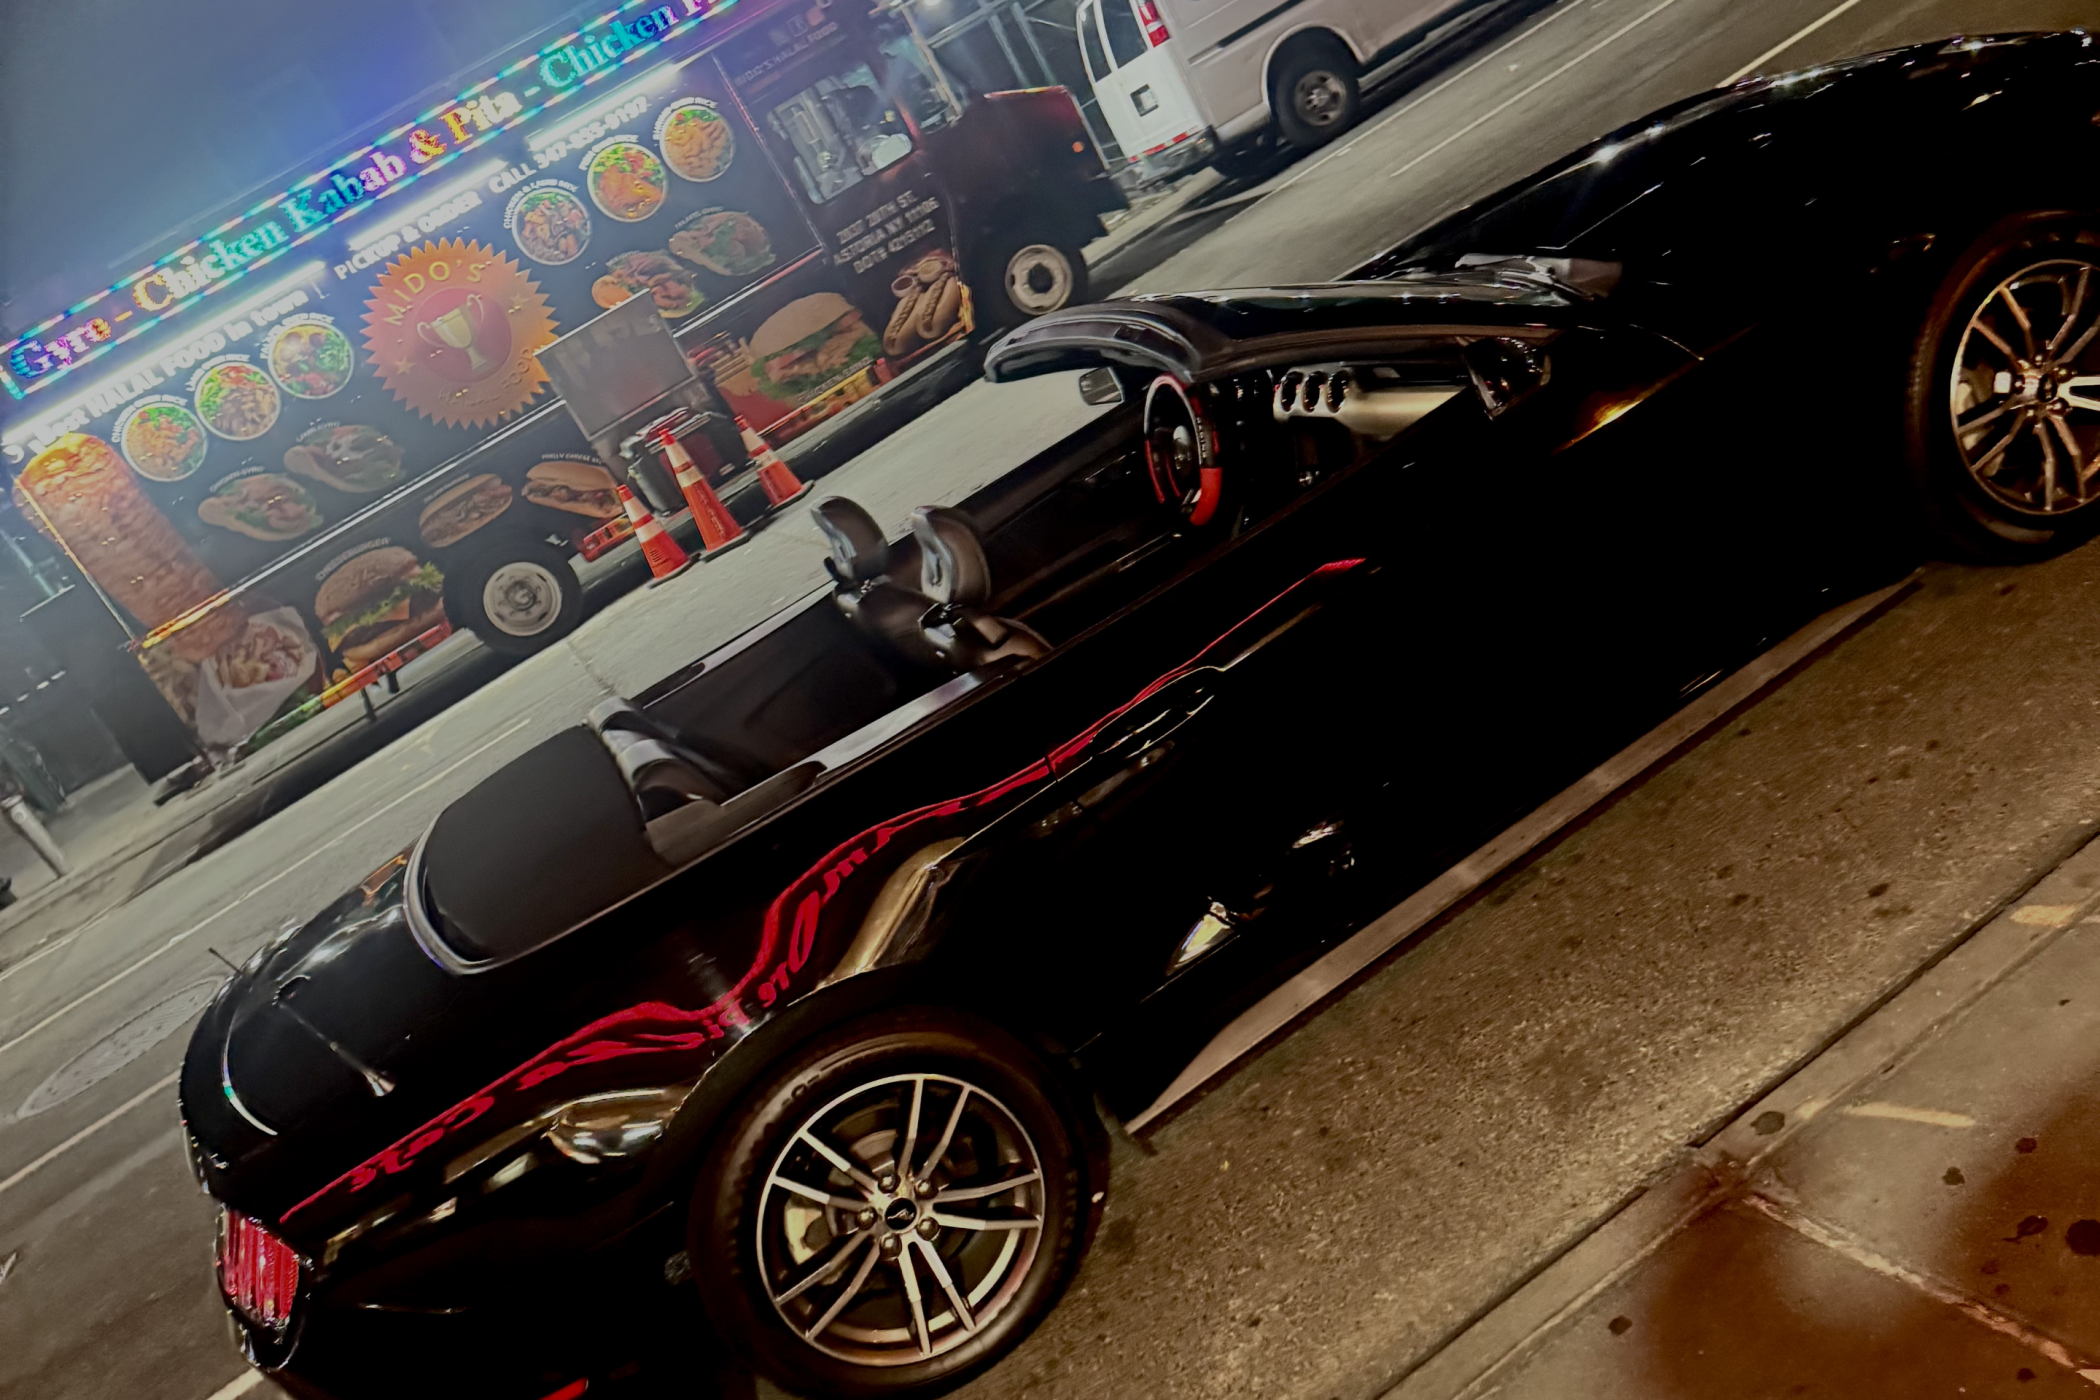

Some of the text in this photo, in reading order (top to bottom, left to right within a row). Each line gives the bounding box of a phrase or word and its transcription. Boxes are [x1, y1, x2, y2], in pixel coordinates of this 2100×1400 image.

[10, 318, 111, 378] Gyro
[133, 221, 289, 311] Chicken
[278, 152, 406, 233] Kabab
[409, 129, 447, 164] &
[439, 90, 523, 145] Pita
[539, 6, 679, 88] Chicken
[488, 163, 537, 194] CALL
[334, 191, 482, 280] PICKUP & ORDER
[834, 228, 887, 266] ASTORIA
[382, 260, 483, 326] MIDO'S
[84, 368, 164, 418] HALAL
[159, 332, 227, 377] FOOD
[249, 289, 309, 328] town
